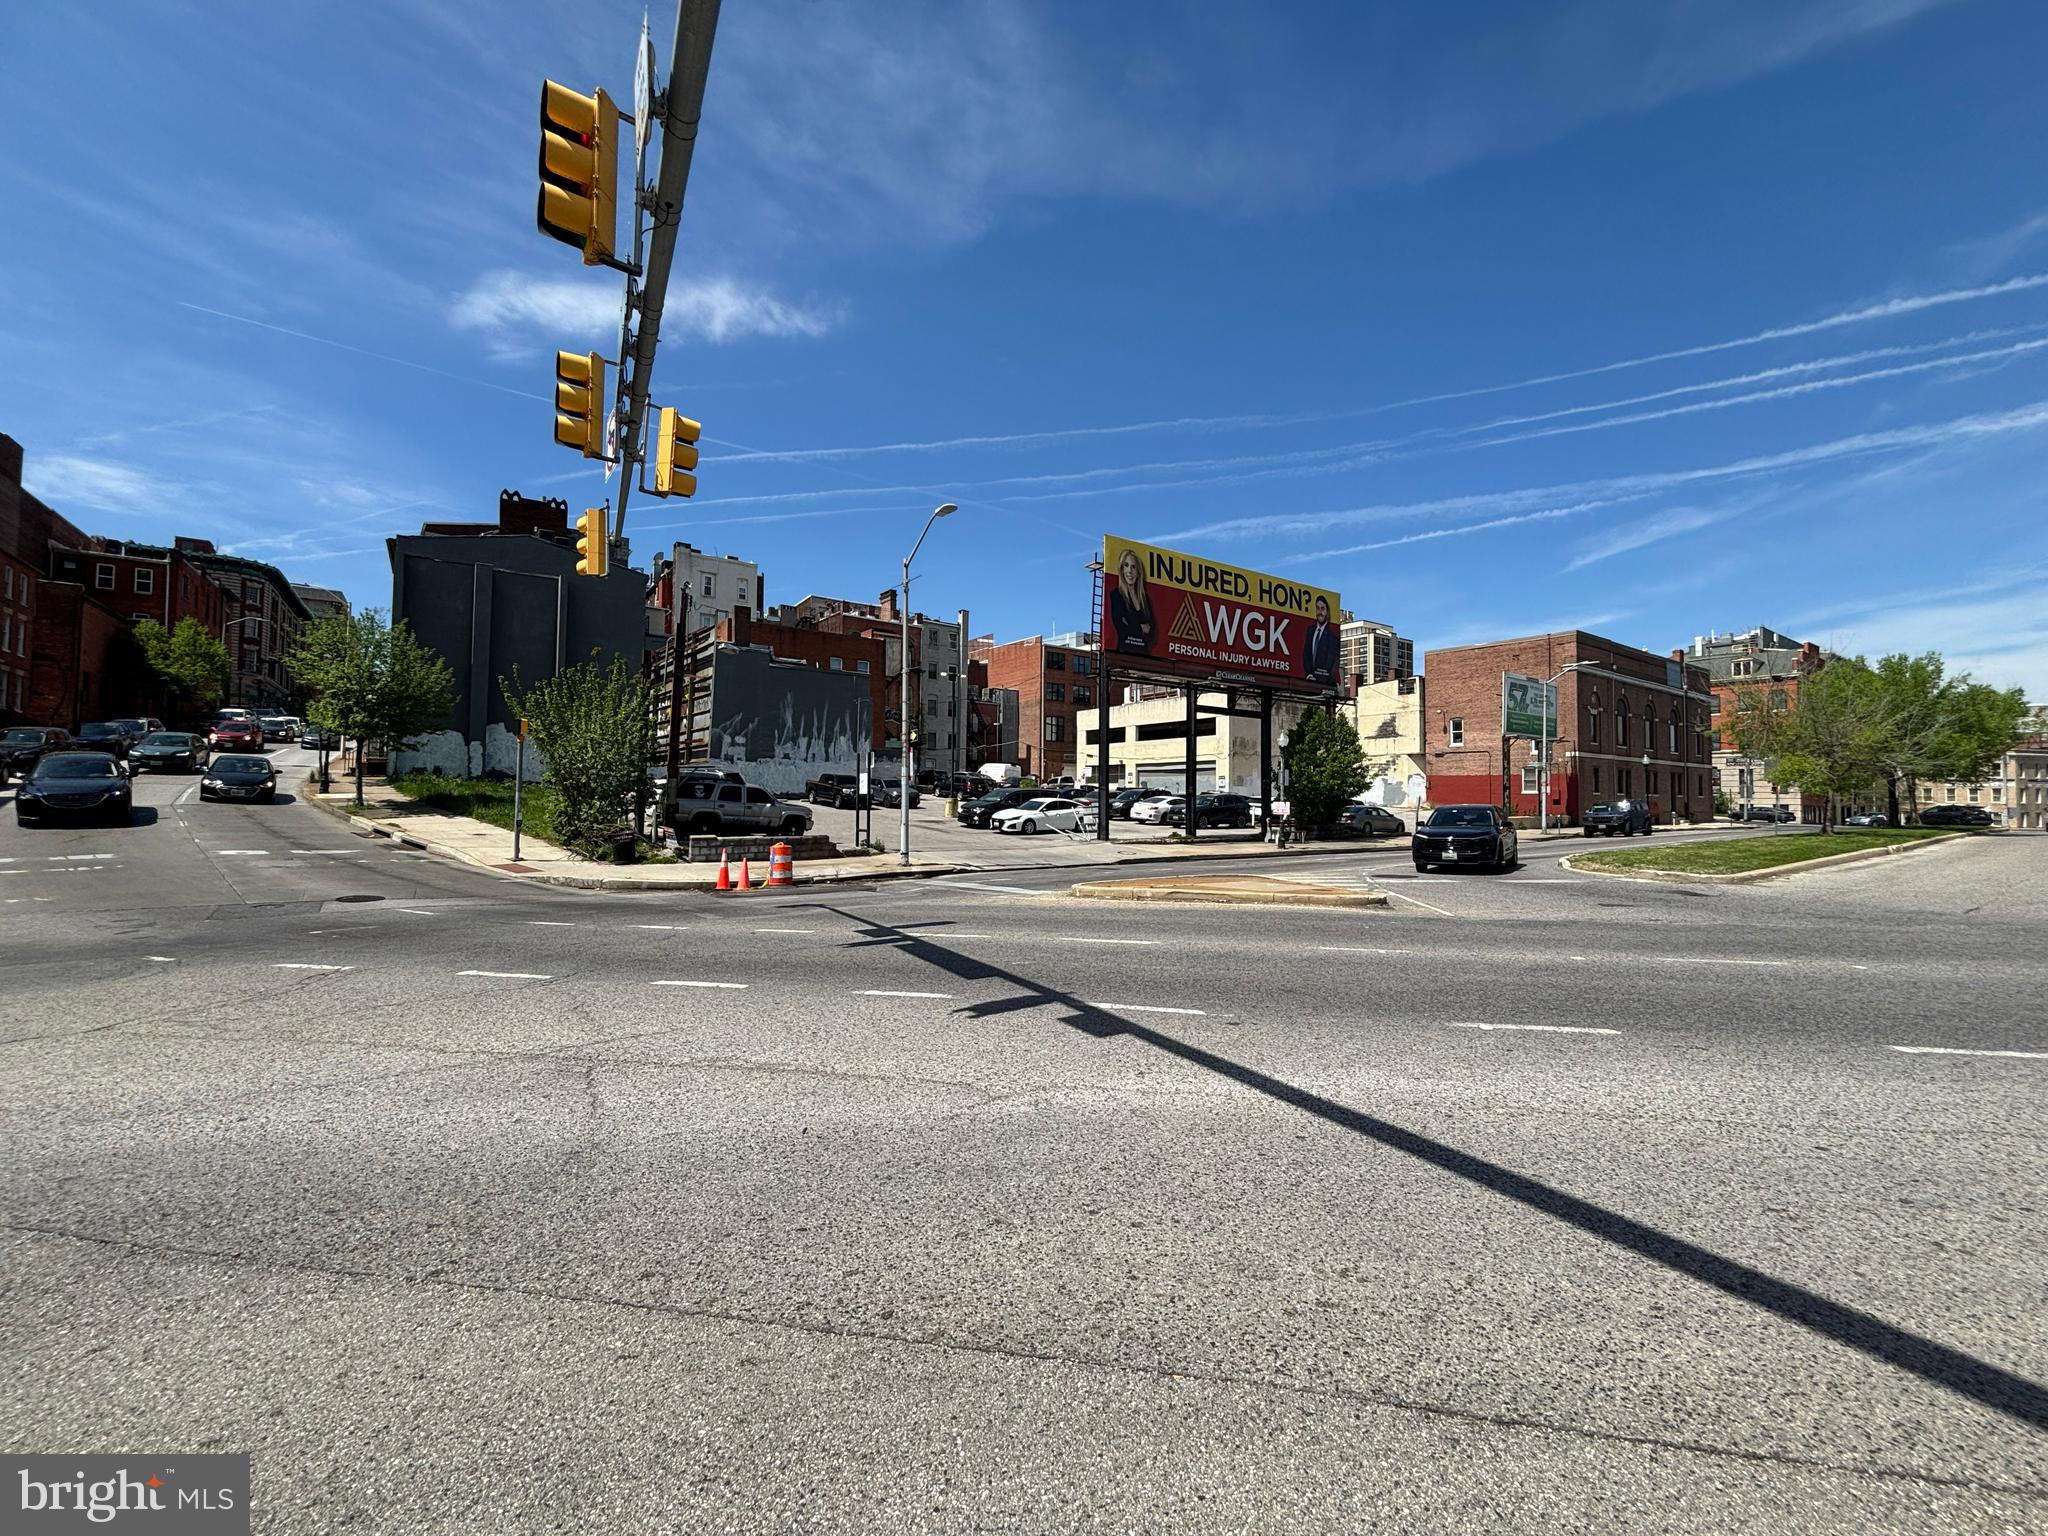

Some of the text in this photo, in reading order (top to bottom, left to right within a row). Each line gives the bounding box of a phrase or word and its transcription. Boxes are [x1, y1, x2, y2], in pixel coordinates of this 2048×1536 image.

[1149, 551, 1312, 612] INJURED, HON?
[1203, 601, 1290, 656] WGK
[1168, 642, 1290, 671] PERSONAL INJURY LAWYERS
